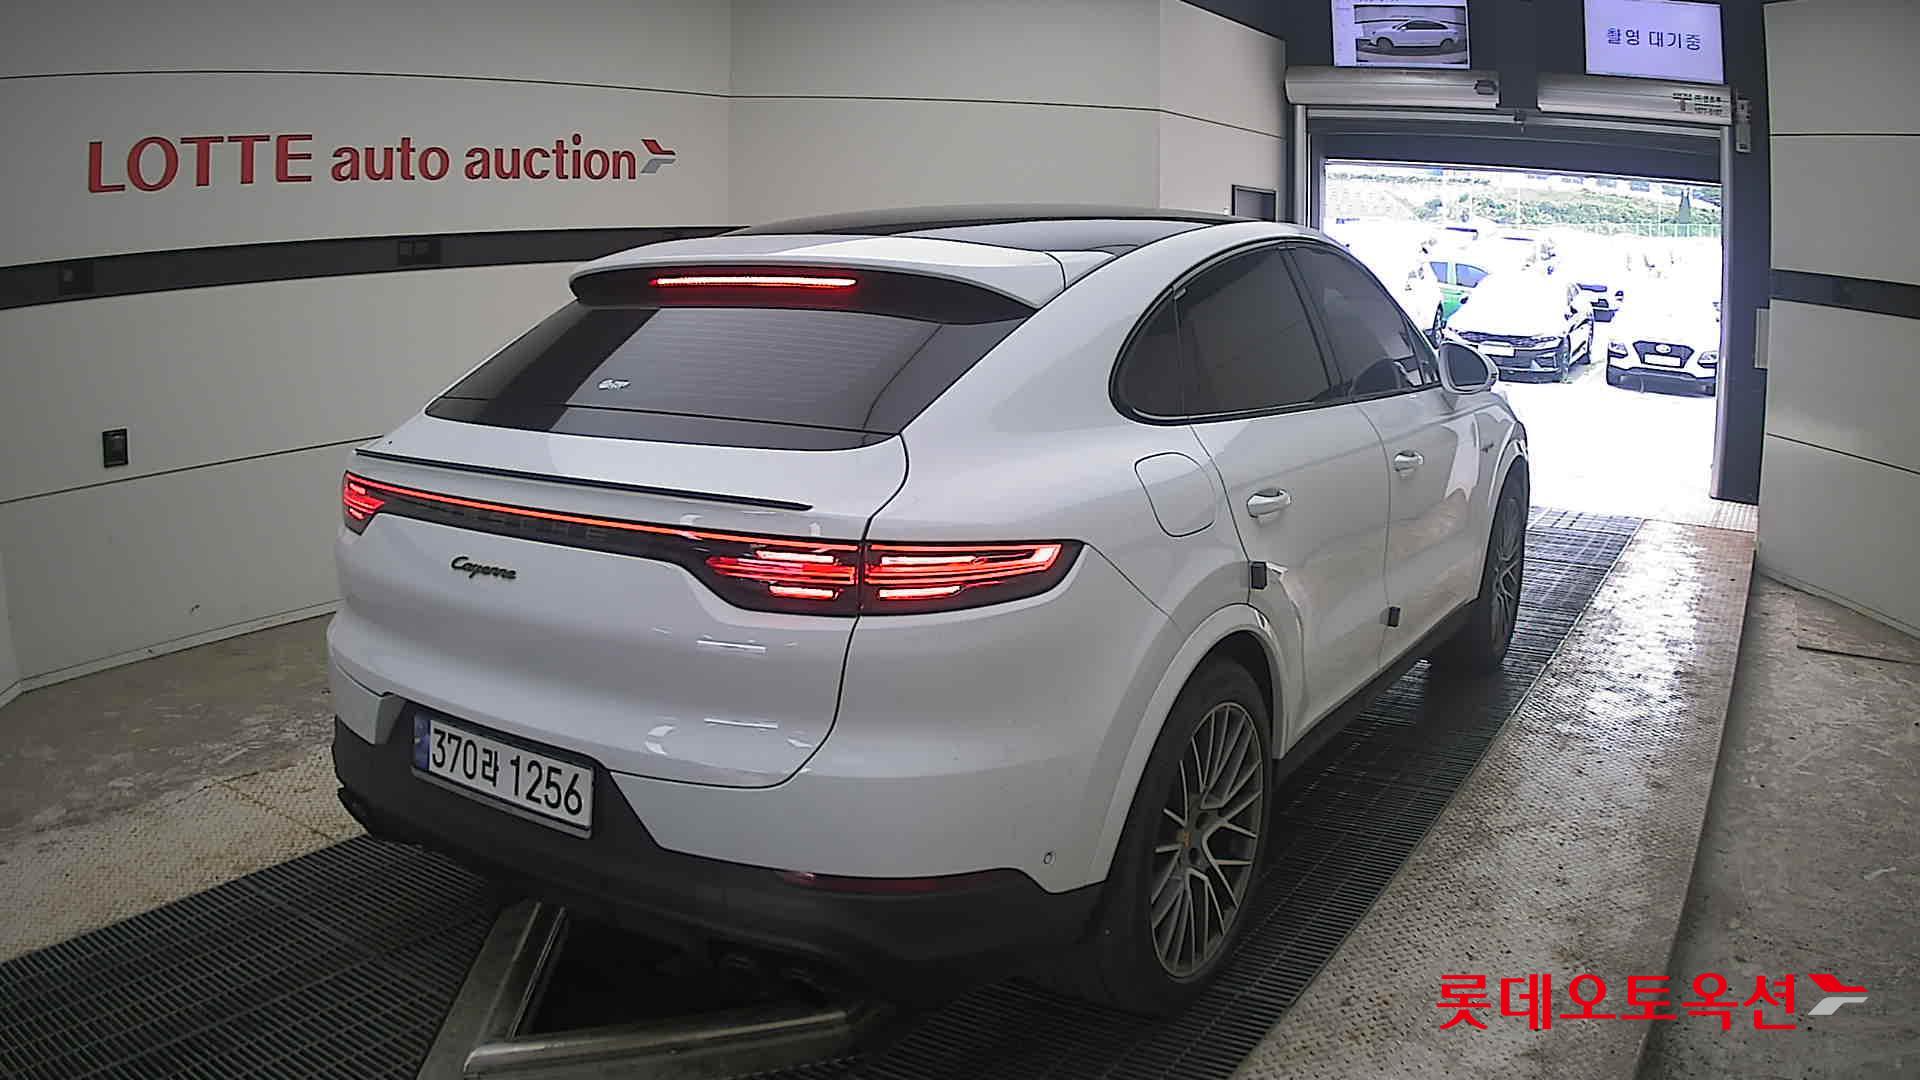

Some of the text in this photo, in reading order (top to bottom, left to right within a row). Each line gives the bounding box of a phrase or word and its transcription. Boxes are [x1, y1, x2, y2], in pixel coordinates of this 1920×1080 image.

[1607, 27, 1701, 51] 촬영 대기중
[88, 133, 637, 193] LOTTE auto auction
[451, 556, 517, 579] Cayenne
[431, 728, 583, 816] 370라 1256
